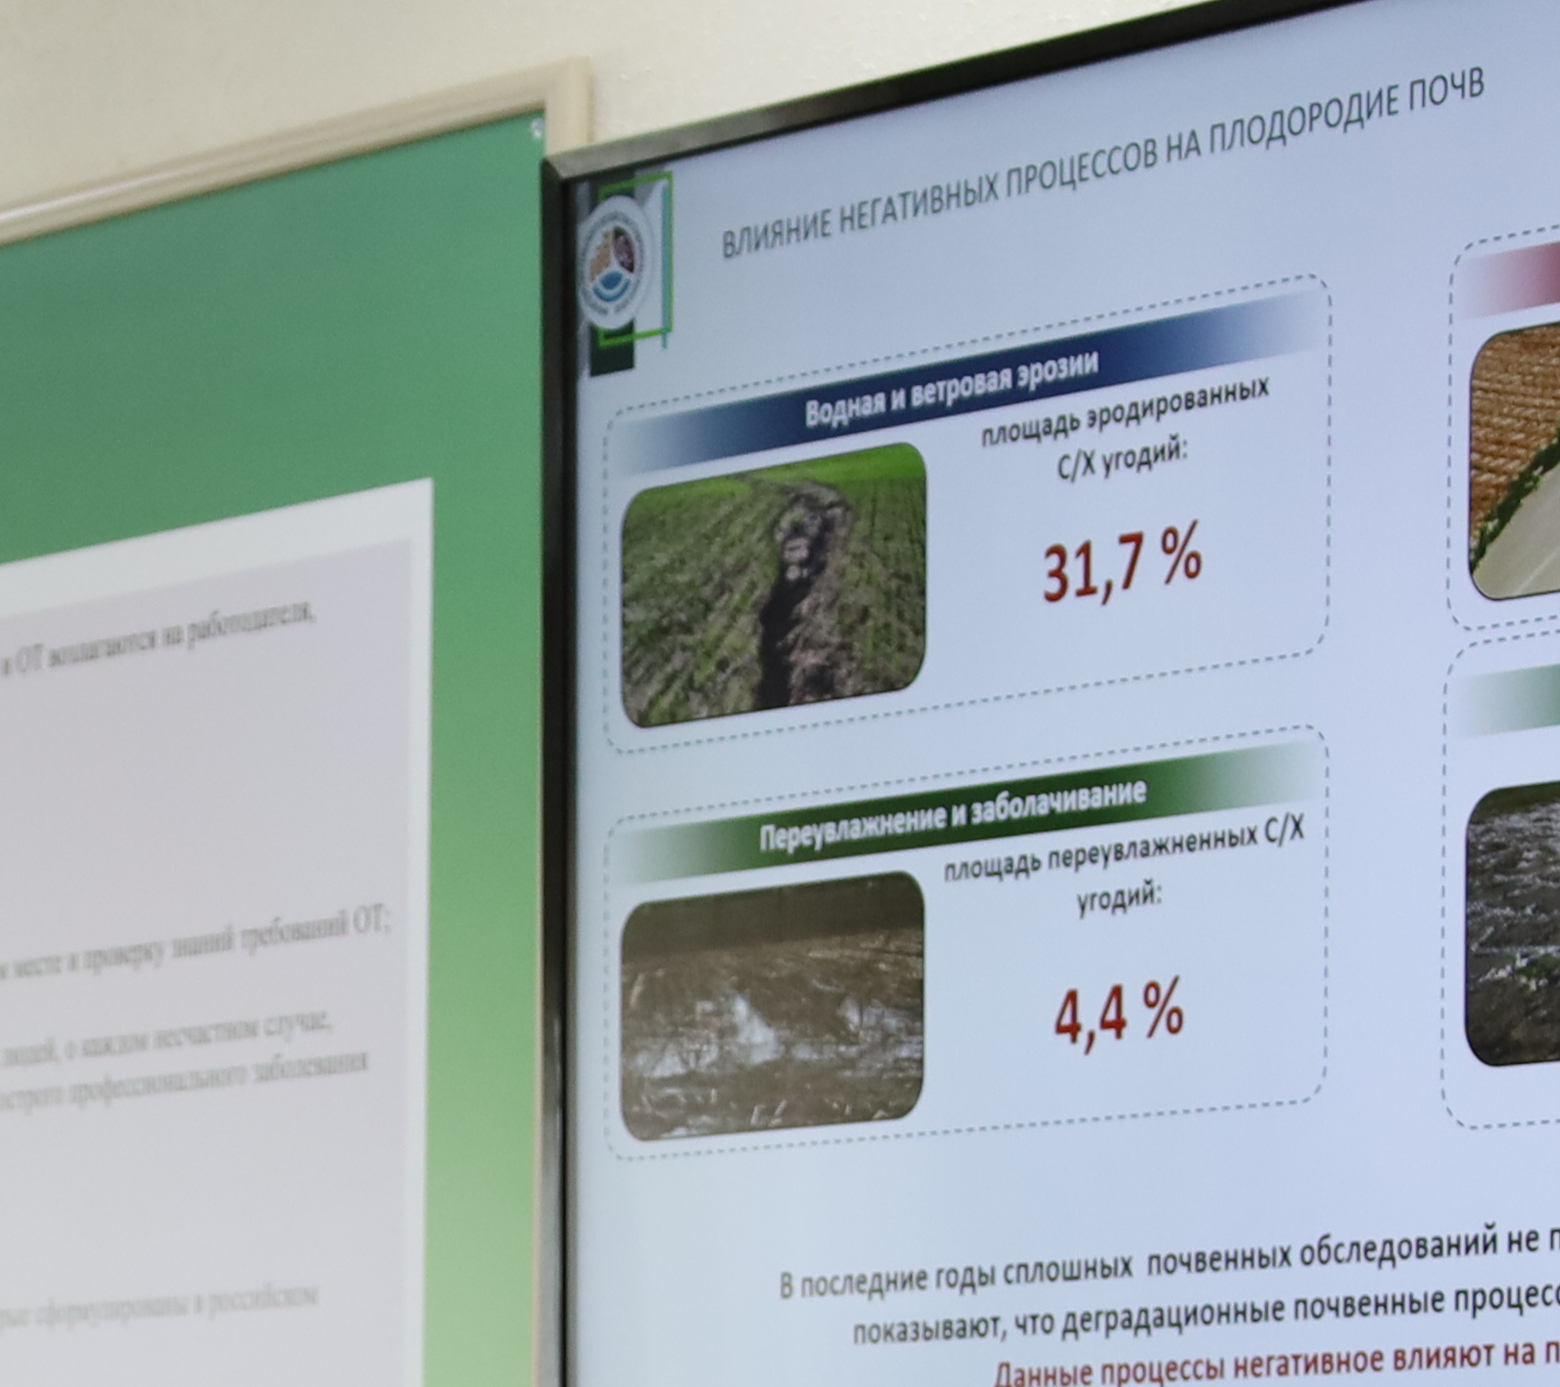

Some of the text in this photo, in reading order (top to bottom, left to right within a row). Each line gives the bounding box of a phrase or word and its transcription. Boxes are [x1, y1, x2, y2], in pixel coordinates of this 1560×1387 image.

[723, 66, 1484, 259] ВЛИЯНИЕ НЕГАТИВНЫХ ПРОЦЕССОВ НА ПЛОДОРОДИЕ ПОЧВ
[806, 352, 1098, 428] Водная и ветровая эрозии
[983, 378, 1269, 446] площадь эродированных
[1102, 434, 1187, 478] угодий:
[1045, 521, 1201, 605] 31,7 %
[761, 781, 1146, 854] Переувлажнение и заболачивание
[945, 854, 1042, 881] площадь
[1048, 827, 1257, 872] переувлажненных
[1077, 879, 1161, 919] угодий:
[1055, 977, 1183, 1054] 4,4 %
[782, 1273, 791, 1298] В
[803, 1271, 927, 1297] последние
[937, 1267, 995, 1294] годы
[1004, 1258, 1132, 1284] сплошных
[1148, 1246, 1291, 1274] почвенных
[1300, 1223, 1497, 1269] обследований
[1508, 1230, 1539, 1253] не
[855, 1317, 1006, 1343] показывают,
[1015, 1314, 1054, 1334] что
[1062, 1300, 1285, 1340] деградационные
[1295, 1291, 1445, 1320] почвенные
[1234, 1350, 1384, 1378] негативное
[1394, 1344, 1494, 1371] влияют
[1504, 1343, 1535, 1365] на
